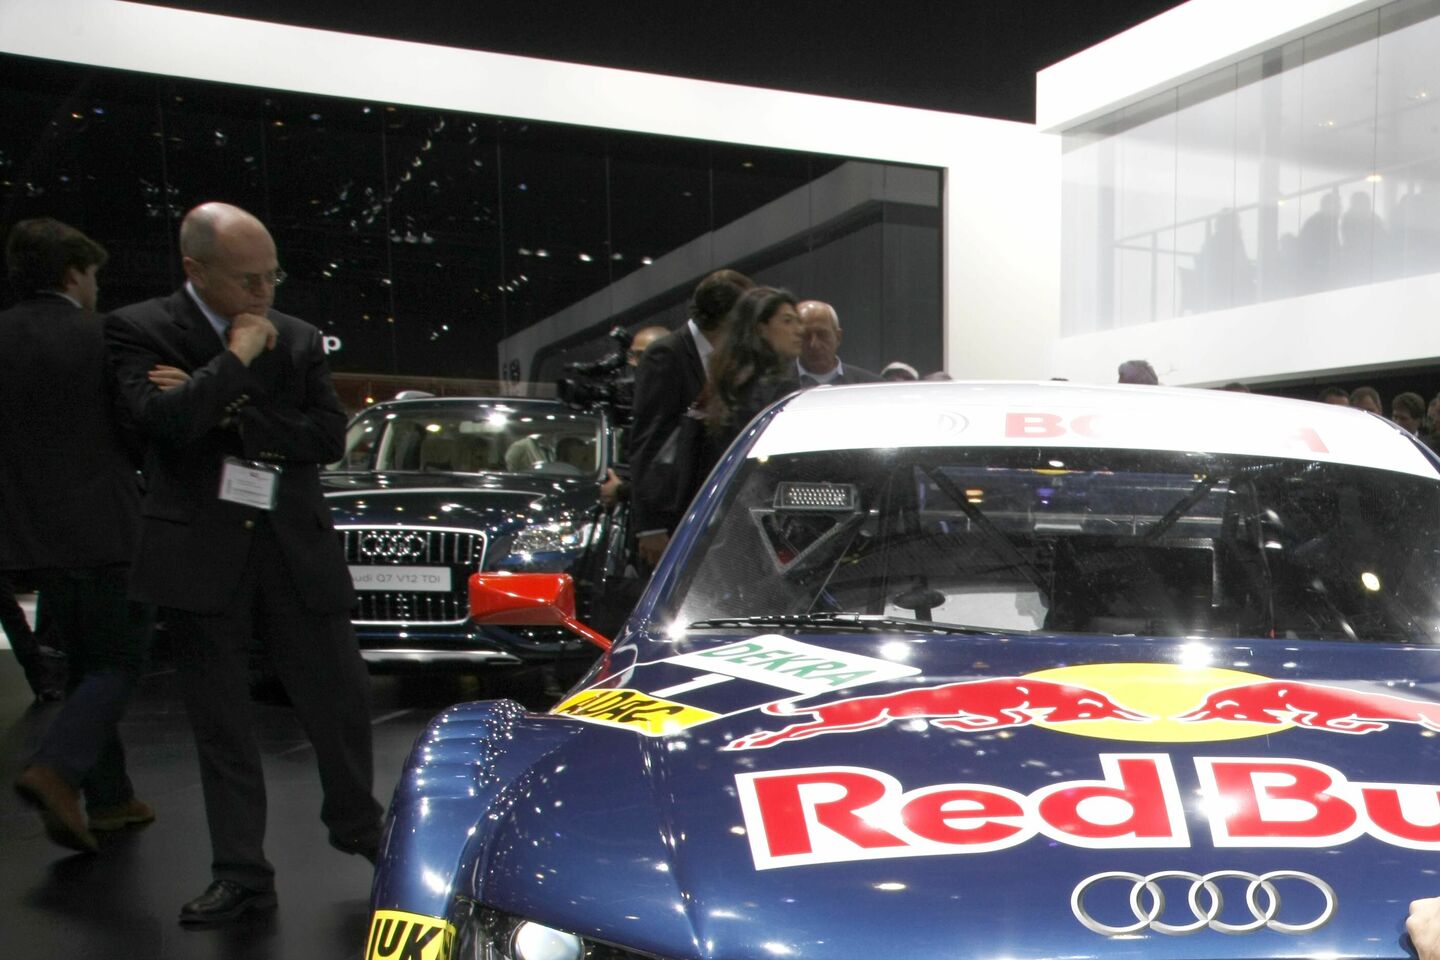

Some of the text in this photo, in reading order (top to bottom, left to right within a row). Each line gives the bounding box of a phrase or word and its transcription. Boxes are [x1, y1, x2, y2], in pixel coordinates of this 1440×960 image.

[376, 574, 393, 584] Q7
[397, 574, 418, 584] V12
[699, 643, 877, 687] DEKRA
[559, 690, 685, 724] ADAC
[754, 758, 1172, 857] Red
